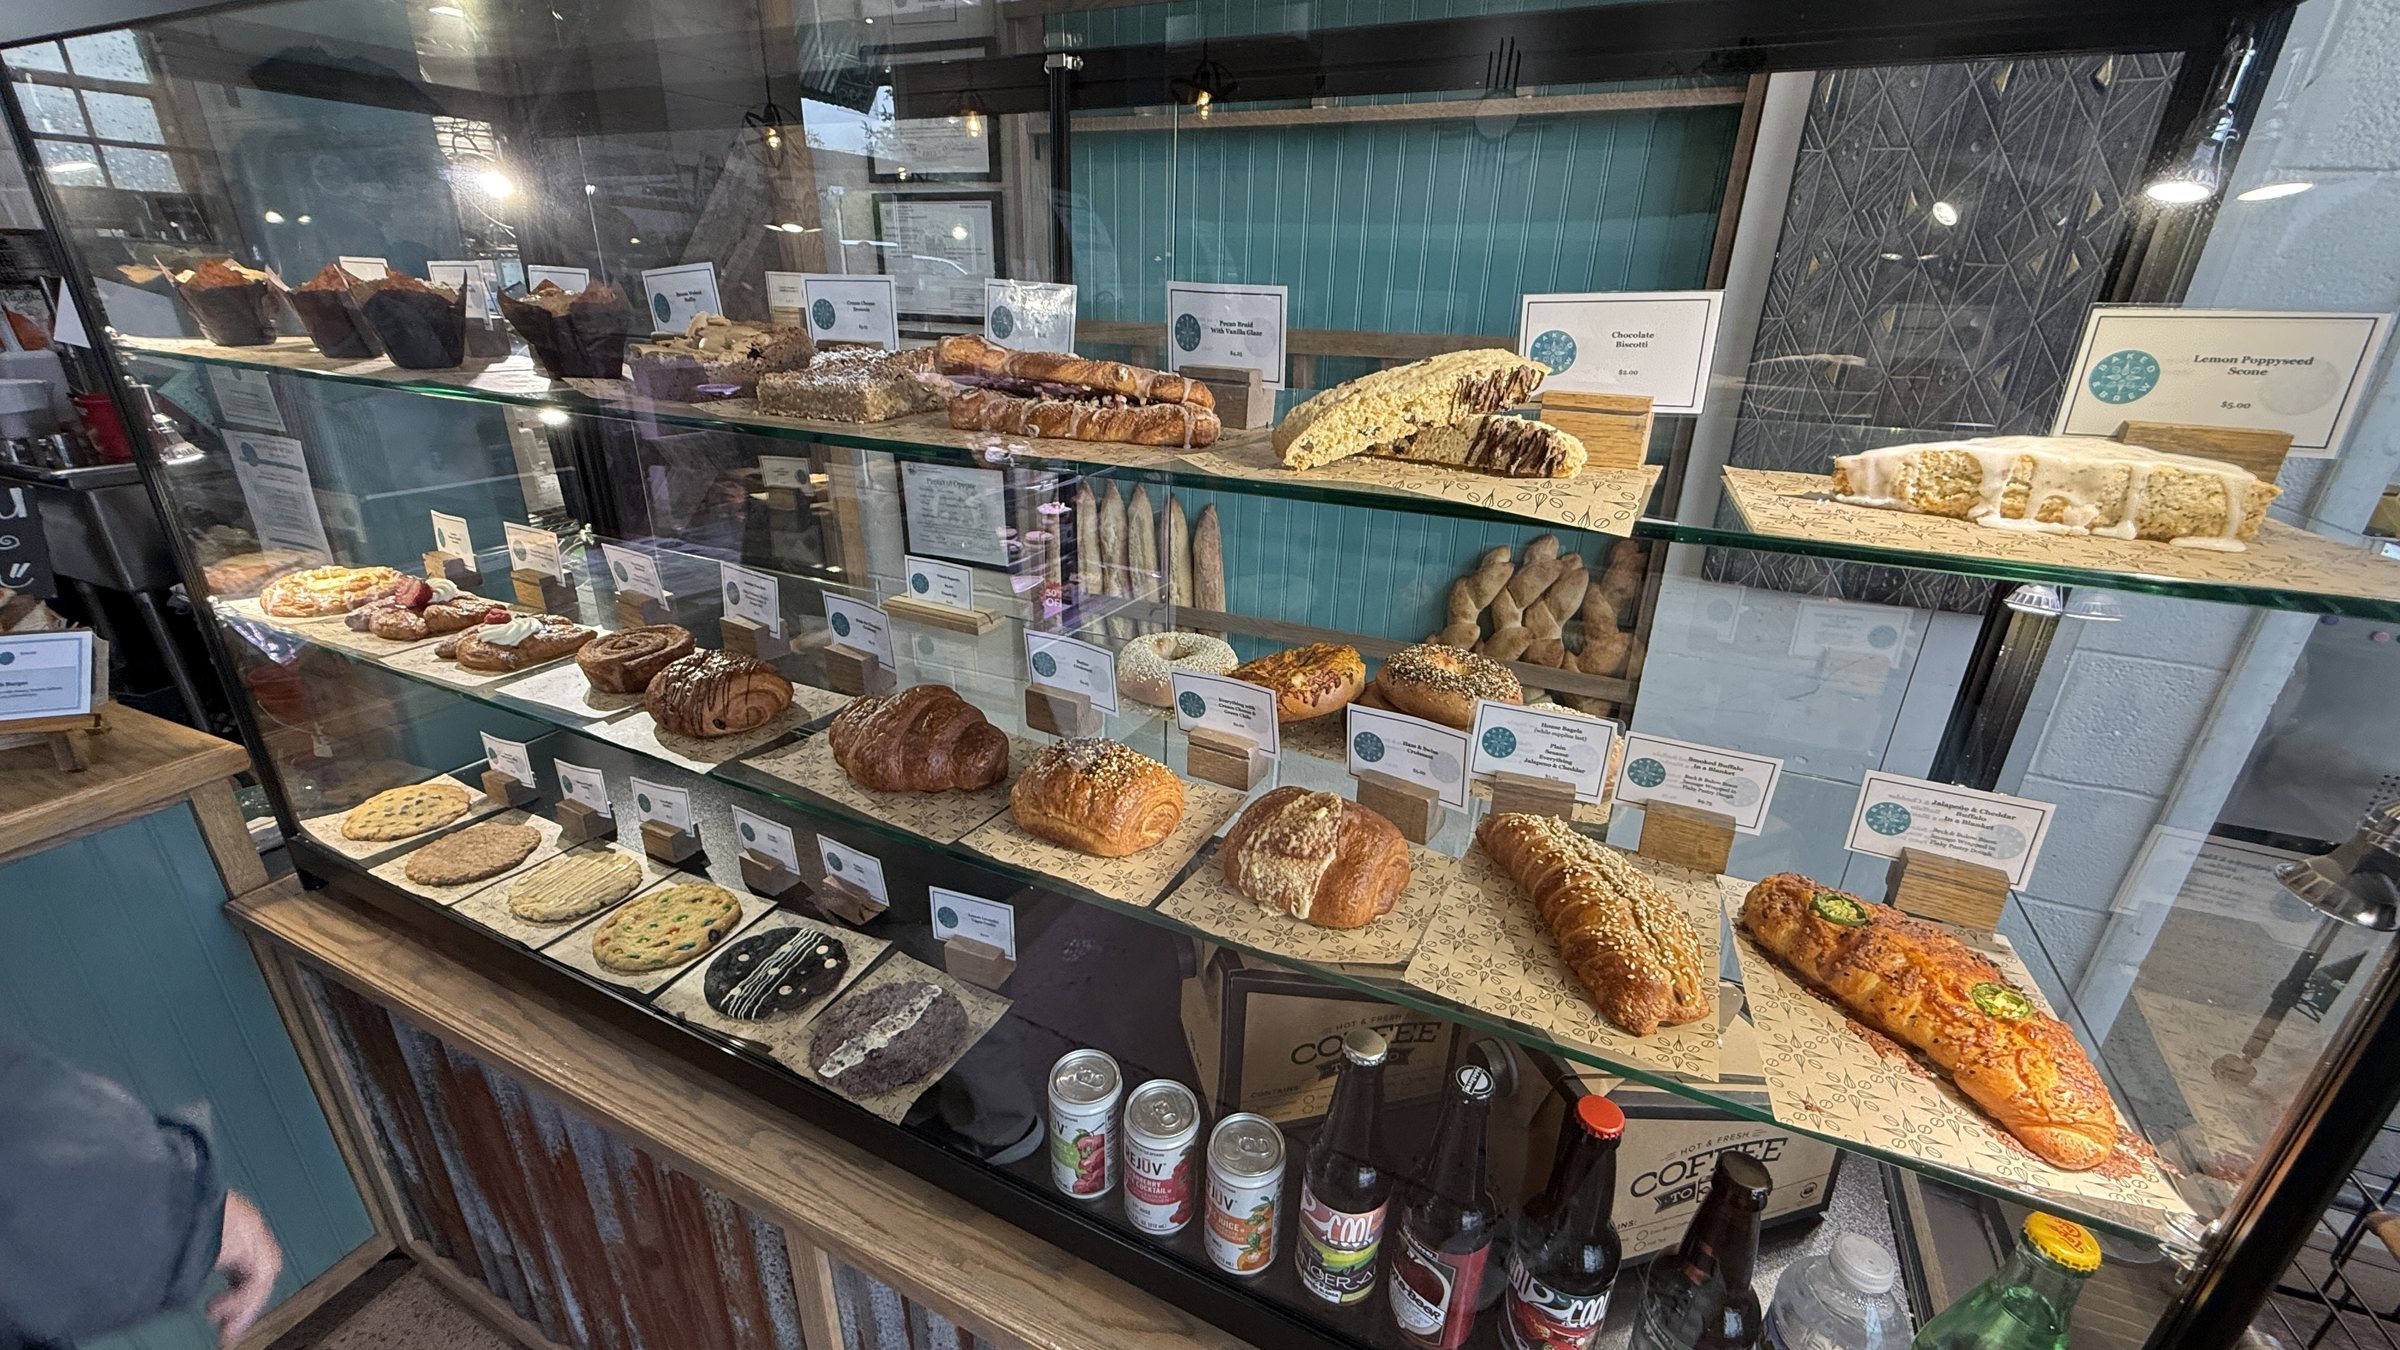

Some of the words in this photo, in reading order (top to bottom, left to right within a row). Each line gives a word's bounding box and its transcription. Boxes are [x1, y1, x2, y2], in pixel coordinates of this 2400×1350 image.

[1225, 328, 1246, 336] Vanilla
[1611, 330, 1655, 339] Chocolate
[1534, 332, 1573, 350] BAKED
[1615, 340, 1649, 349] Biscotti
[2097, 352, 2156, 373] BAKED
[2193, 354, 2239, 365] Lemon
[2239, 354, 2315, 367] Poppyseed
[1618, 368, 1639, 377] $2.00
[2227, 366, 2268, 377] Scone
[2097, 381, 2153, 403] BREW
[2219, 400, 2252, 410] $5.00
[1541, 722, 1562, 731] House
[1561, 725, 1583, 735] Bagels
[1544, 749, 1570, 758] Sesame
[1549, 743, 1567, 751] Plain
[1538, 753, 1573, 766] Everything
[1687, 756, 1718, 767] Smoked
[1717, 761, 1744, 772] Buffalo
[1558, 764, 1586, 774] Cheddar
[1707, 765, 1736, 777] Blanket
[1931, 798, 1970, 813] Jalapeño
[1978, 807, 2017, 821] Cheddar
[1955, 810, 1987, 822] Buffalo
[1961, 818, 1994, 831] Blanket
[1290, 1021, 1442, 1066] COFEE
[1680, 1142, 1701, 1157] HOT
[1705, 1139, 1713, 1149] &
[1717, 1130, 1752, 1144] FRESH
[1629, 1137, 1790, 1199] COFEE
[1135, 1181, 1167, 1194] COCKTAIL
[1670, 1186, 1695, 1203] TO
[1218, 1218, 1240, 1232] JUICE
